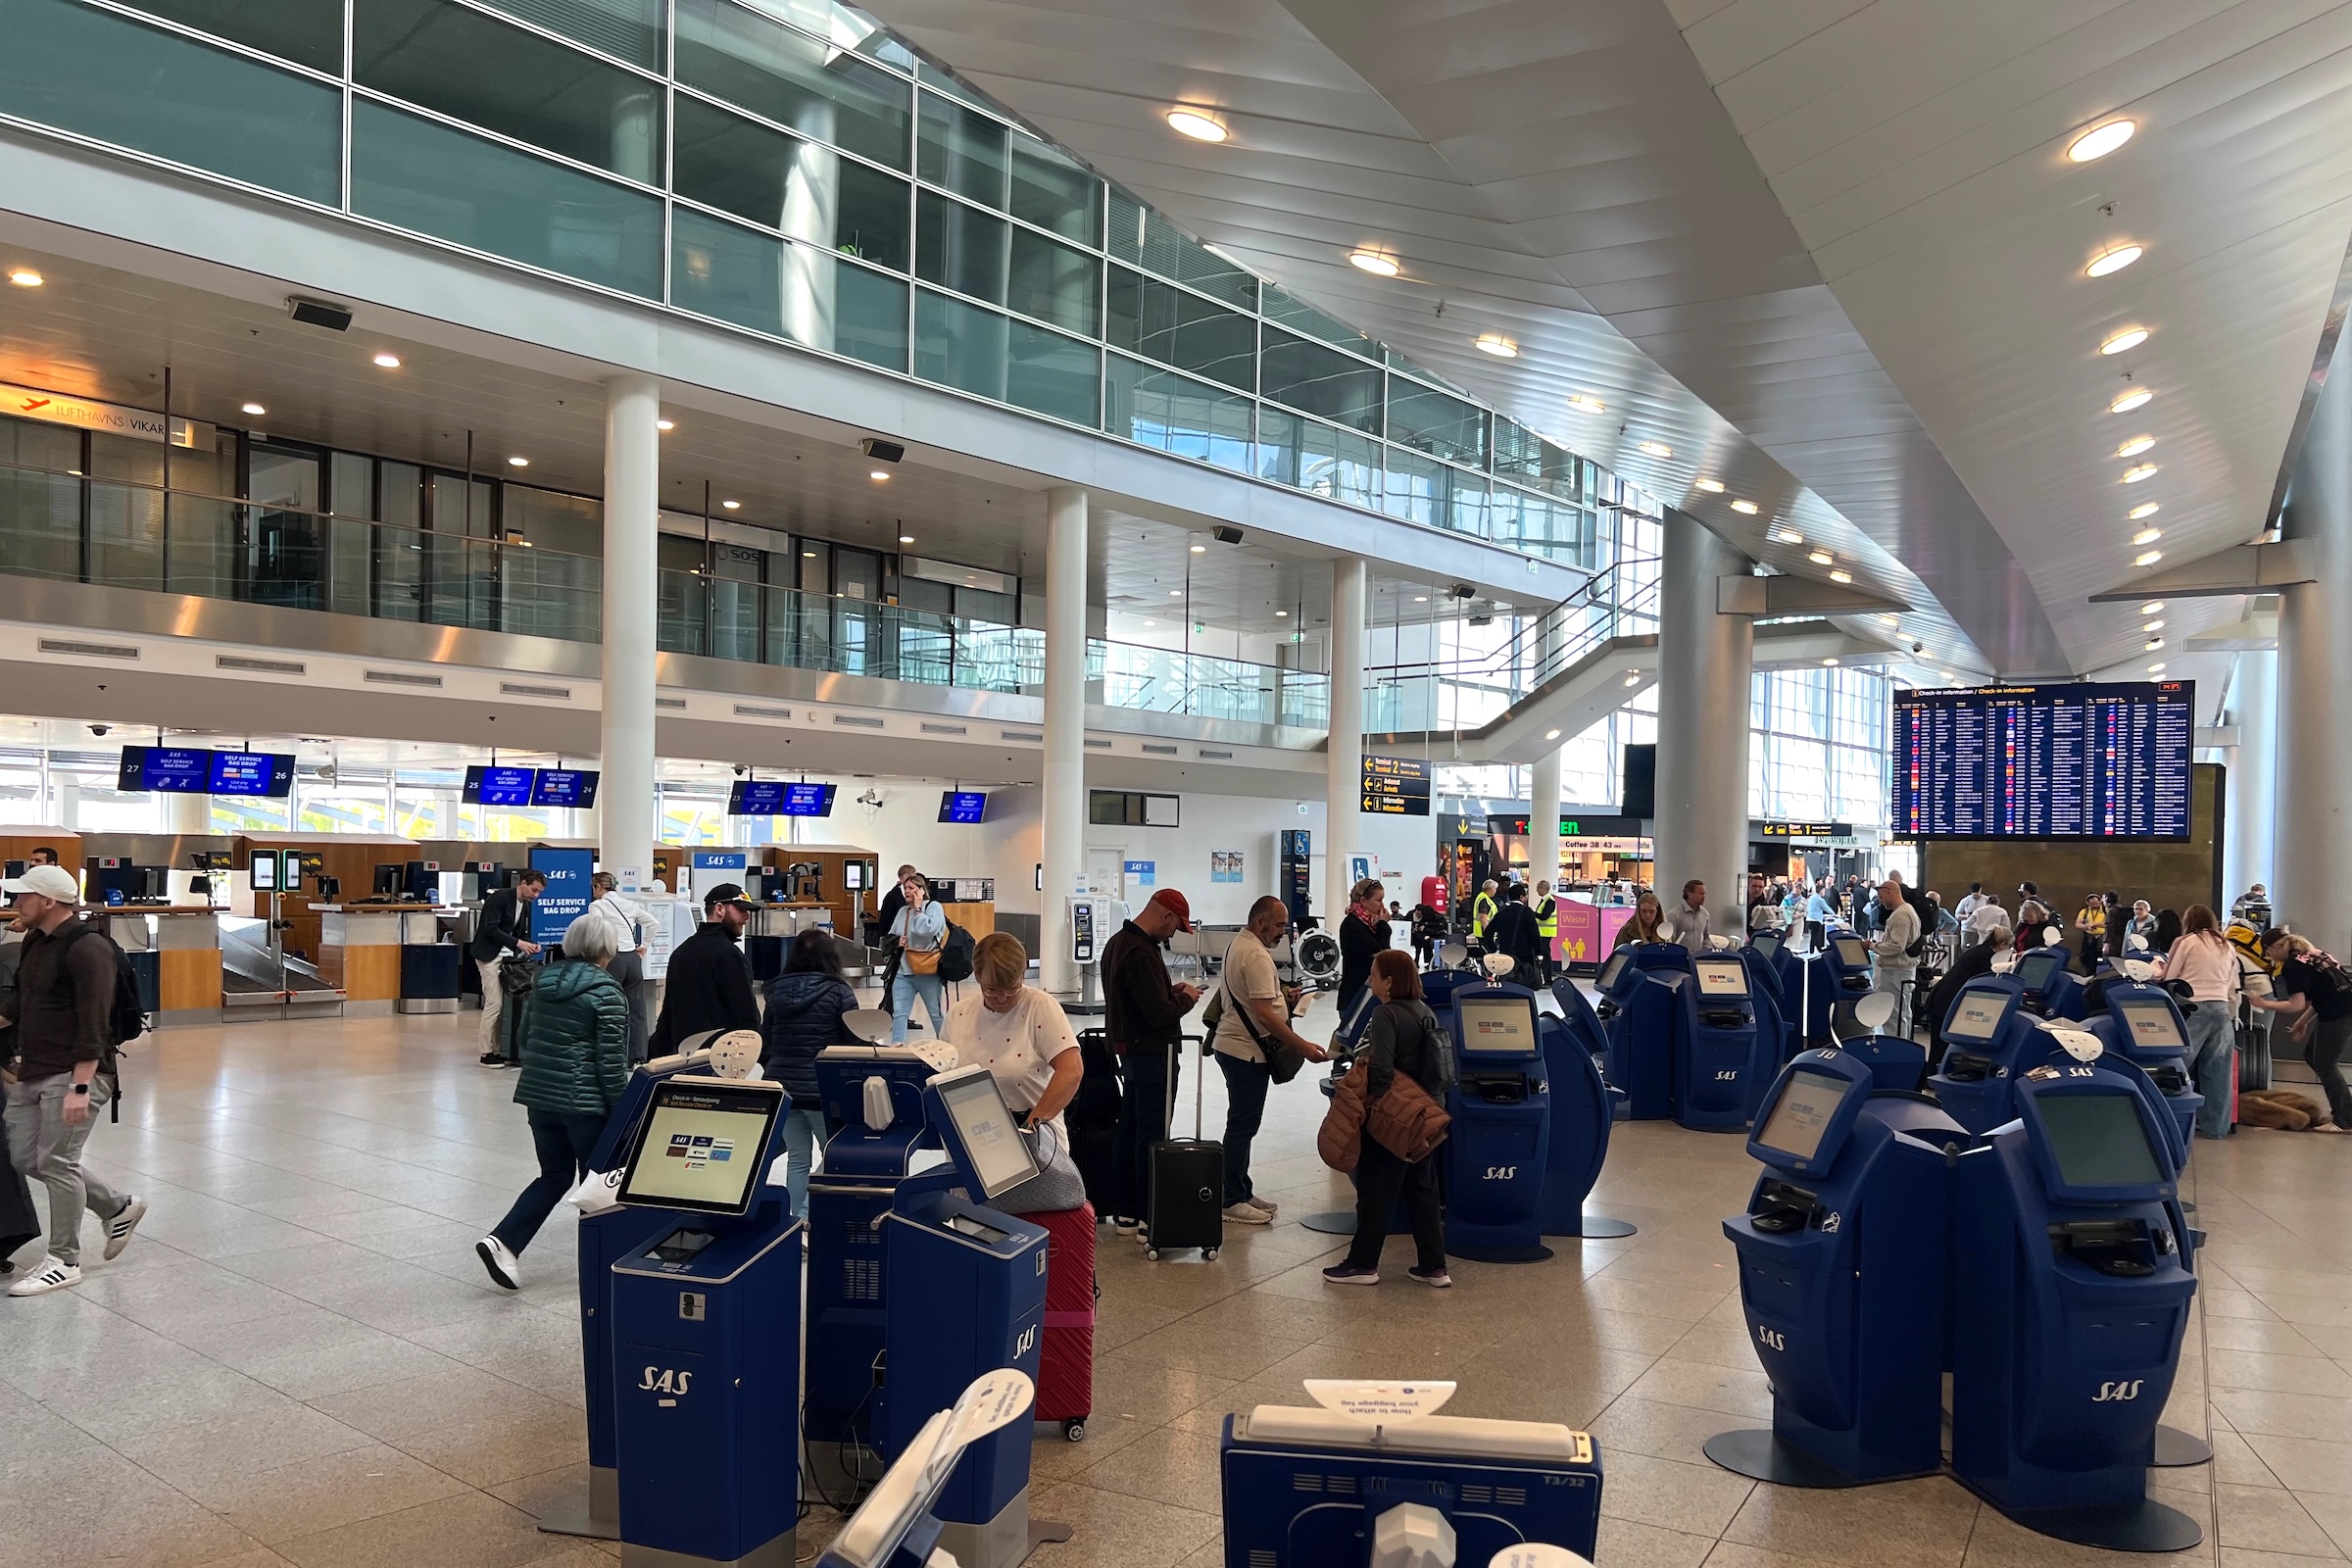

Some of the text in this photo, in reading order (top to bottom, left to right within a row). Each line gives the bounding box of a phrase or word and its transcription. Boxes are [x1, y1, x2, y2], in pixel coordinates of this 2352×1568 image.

[56, 405, 165, 435] LUFTHAVNS VIKAR
[126, 764, 139, 773] 27
[1393, 760, 1399, 774] 2
[275, 771, 287, 780] 26
[706, 857, 724, 865] SAS
[549, 870, 567, 879] SAS
[1562, 914, 1587, 924] Waste
[1714, 1070, 1738, 1080] SAS
[2069, 1067, 2094, 1077] SAS
[1483, 1166, 1517, 1179] SAS
[1013, 1323, 1037, 1359] SAS
[1758, 1325, 1785, 1350] SAS
[638, 1366, 693, 1395] SAS
[2091, 1380, 2144, 1401] SAS
[1358, 1399, 1396, 1408] baggage
[1544, 1475, 1586, 1488] T3/32
